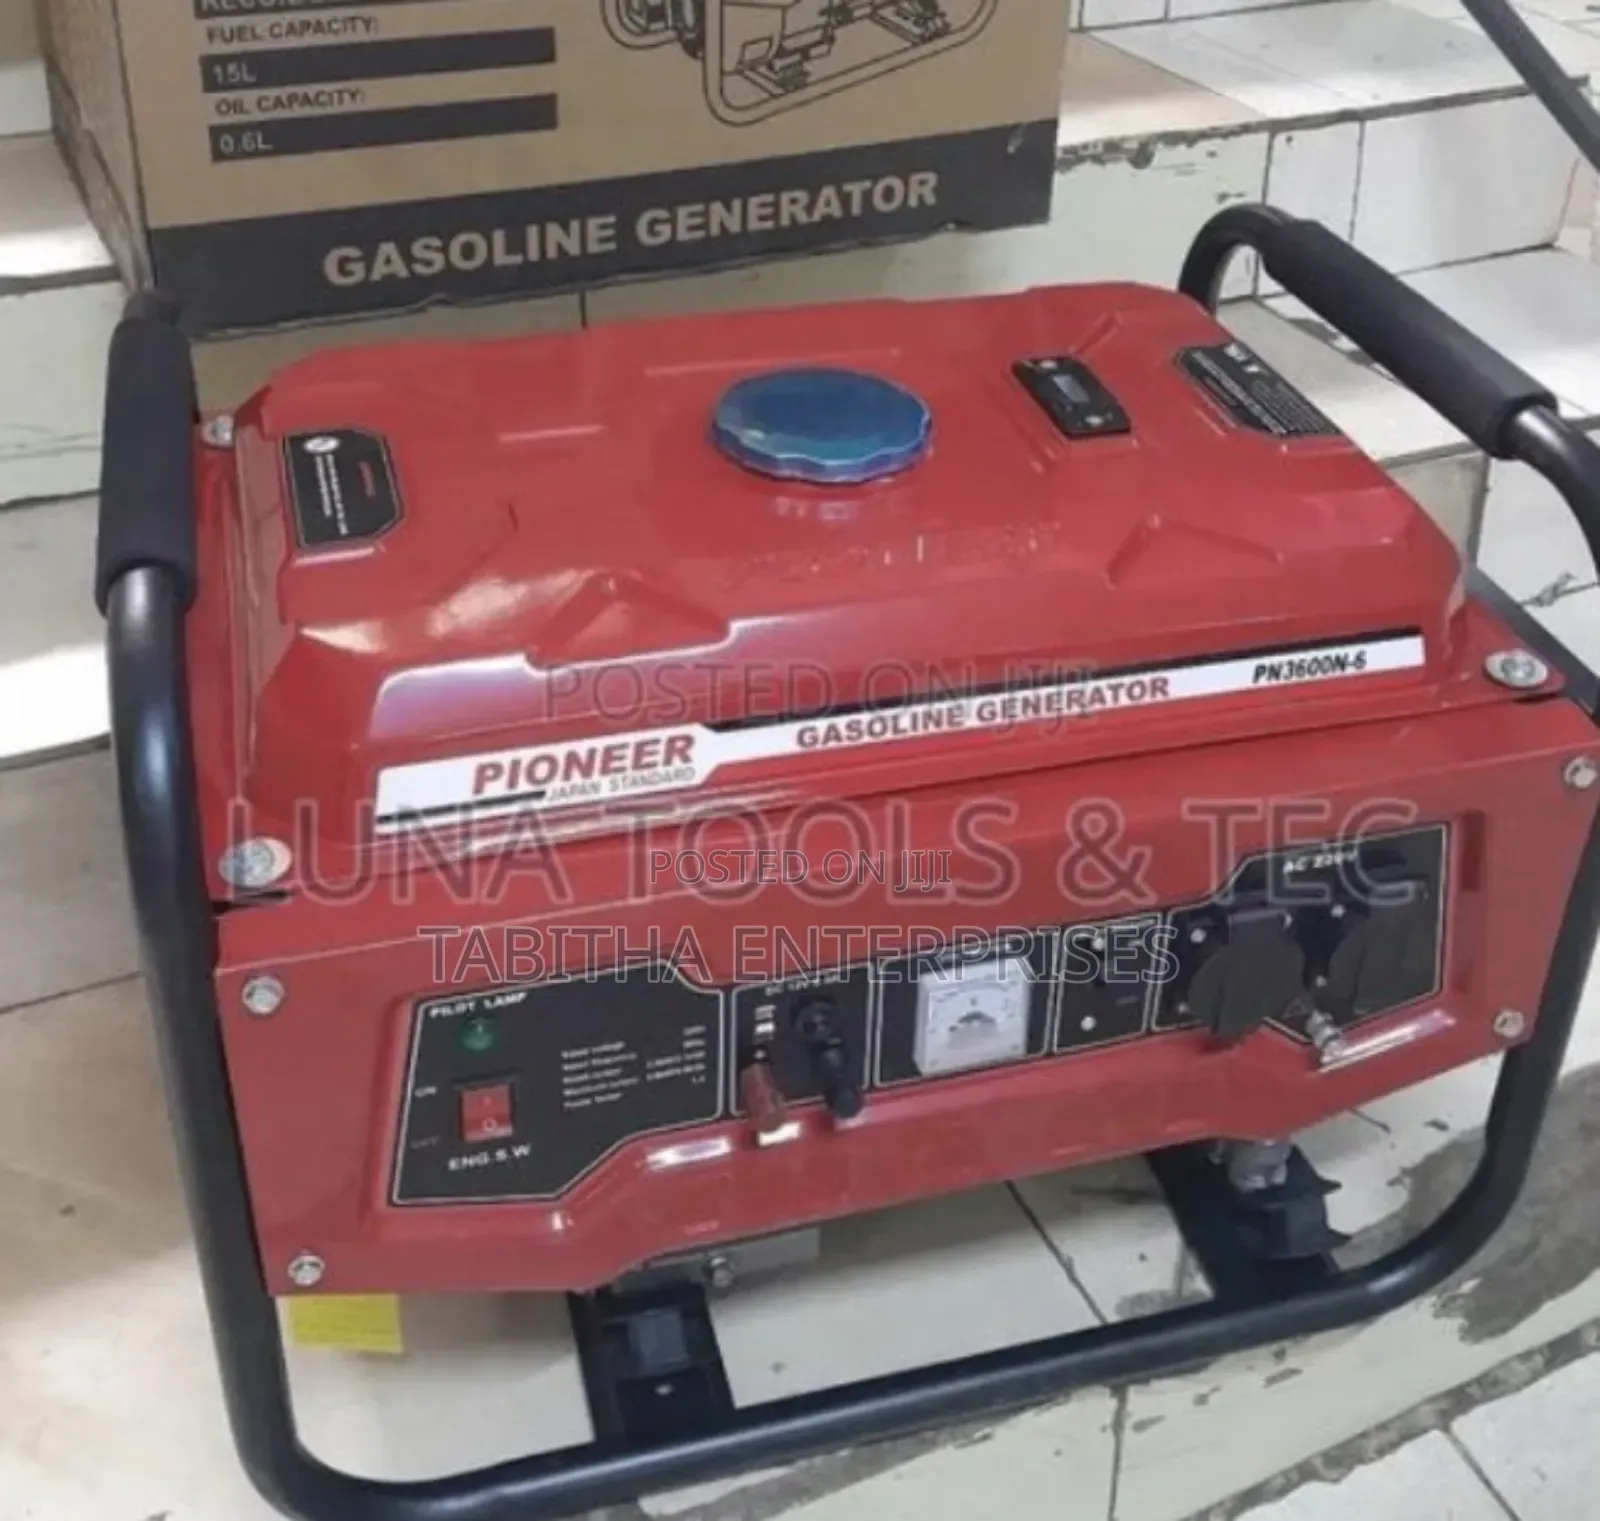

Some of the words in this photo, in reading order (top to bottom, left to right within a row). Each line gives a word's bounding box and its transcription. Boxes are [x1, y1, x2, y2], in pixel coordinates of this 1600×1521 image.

[206, 22, 263, 44] FUEL
[212, 61, 257, 85] 15L
[215, 97, 252, 116] OIL
[220, 129, 273, 155] 0.6L
[323, 215, 617, 287] GASOLINE
[635, 170, 939, 247] GENERATOR
[795, 708, 965, 751] GASOLINE
[976, 676, 1170, 724] GENERATOR
[473, 733, 696, 796] PIONEER
[550, 779, 601, 799] JAPAN
[608, 766, 697, 792] STANDARD
[429, 1001, 475, 1018] PILOT
[484, 992, 527, 1009] LAMP
